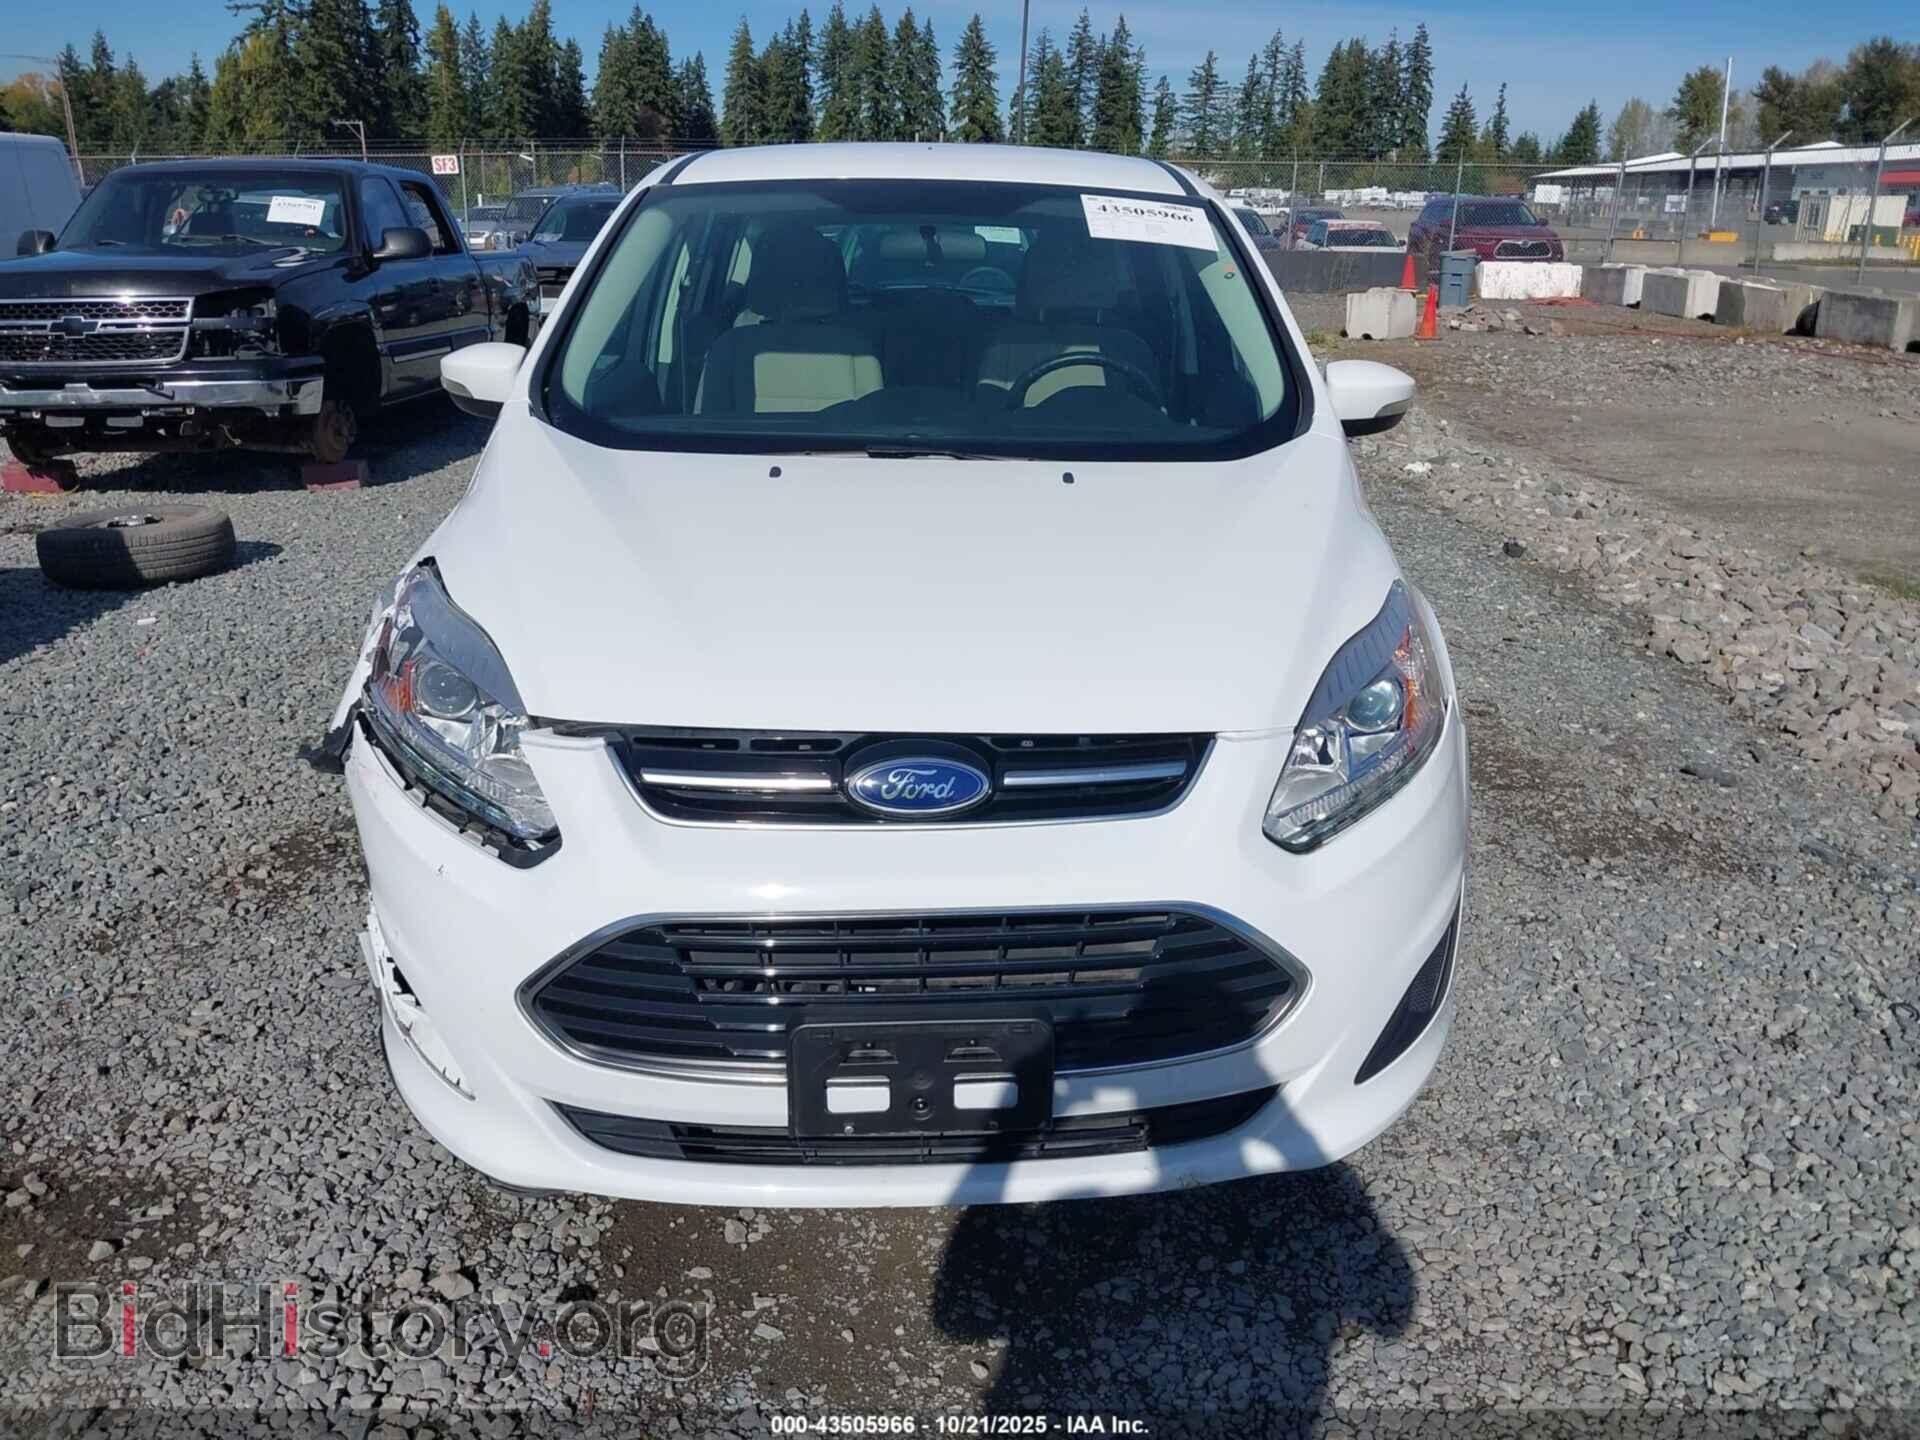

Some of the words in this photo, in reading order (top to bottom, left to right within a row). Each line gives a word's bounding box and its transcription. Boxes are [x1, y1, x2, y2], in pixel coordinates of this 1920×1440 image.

[434, 157, 456, 172] SF3
[1097, 204, 1194, 222] 43505966
[881, 768, 955, 800] Ford
